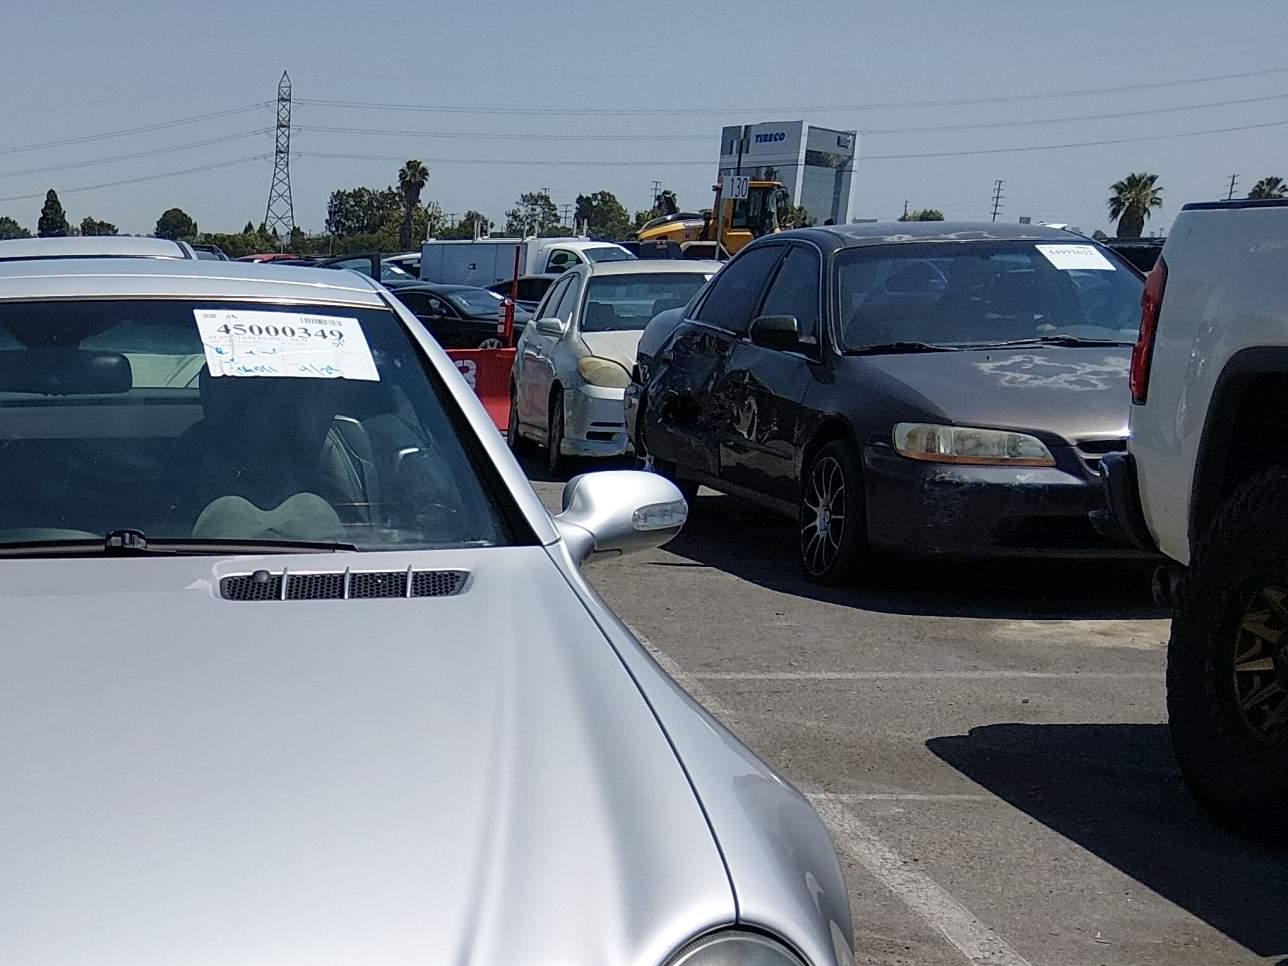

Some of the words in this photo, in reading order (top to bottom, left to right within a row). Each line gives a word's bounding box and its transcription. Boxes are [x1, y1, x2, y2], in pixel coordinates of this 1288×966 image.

[755, 132, 786, 144] TIRECO
[730, 177, 748, 198] 130
[216, 323, 344, 341] 45000349
